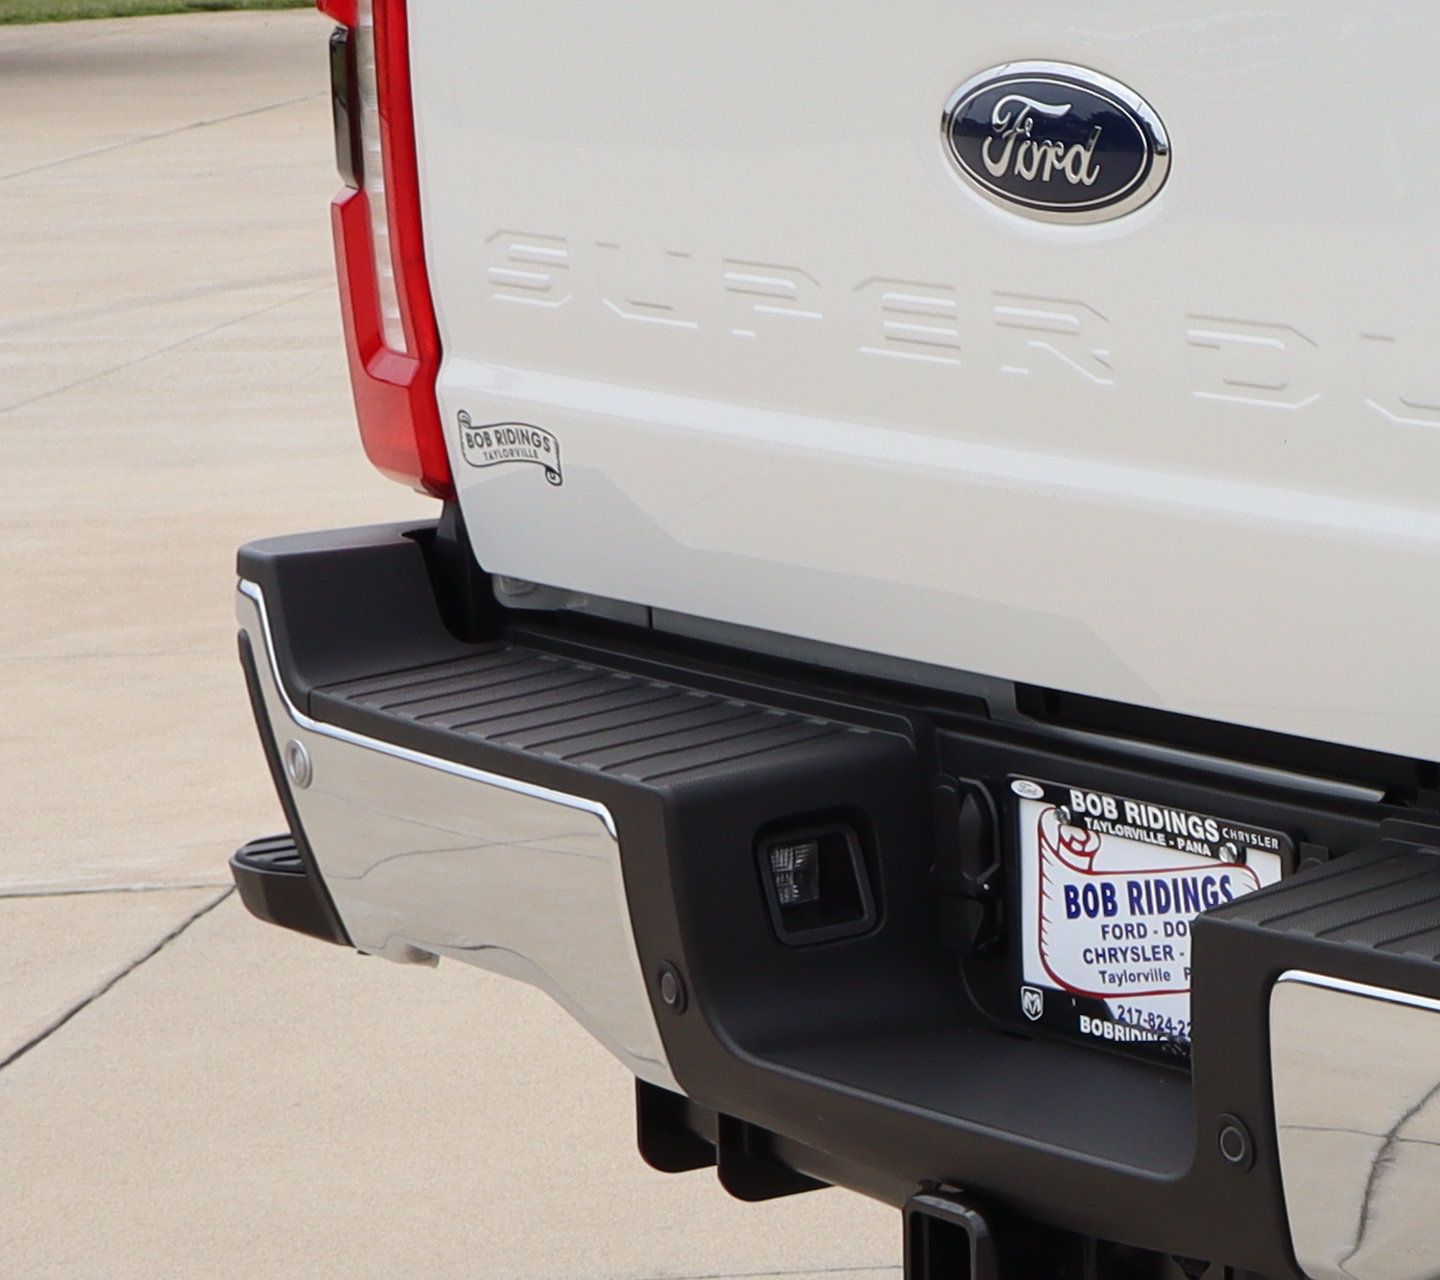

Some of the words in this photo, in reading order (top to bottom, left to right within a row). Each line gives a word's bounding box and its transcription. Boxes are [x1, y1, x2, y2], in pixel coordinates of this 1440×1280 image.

[981, 93, 1103, 187] Ford
[483, 228, 1117, 387] SUPER
[465, 430, 493, 449] BOB
[495, 428, 551, 453] RIDINGS
[483, 447, 540, 462] TAYLORVILLE
[1069, 789, 1119, 820] BOB
[1124, 800, 1221, 844] RIDINGS
[1083, 815, 1167, 847] TAYLORVILLE
[1176, 837, 1213, 858] PANA
[1222, 826, 1280, 851] CHRYSLER
[1064, 882, 1118, 920] BOB
[1127, 874, 1234, 917] RIDINGS
[1101, 923, 1148, 941] FORD
[1082, 945, 1175, 965] CHRYSLER
[1098, 968, 1172, 987] Taylorville
